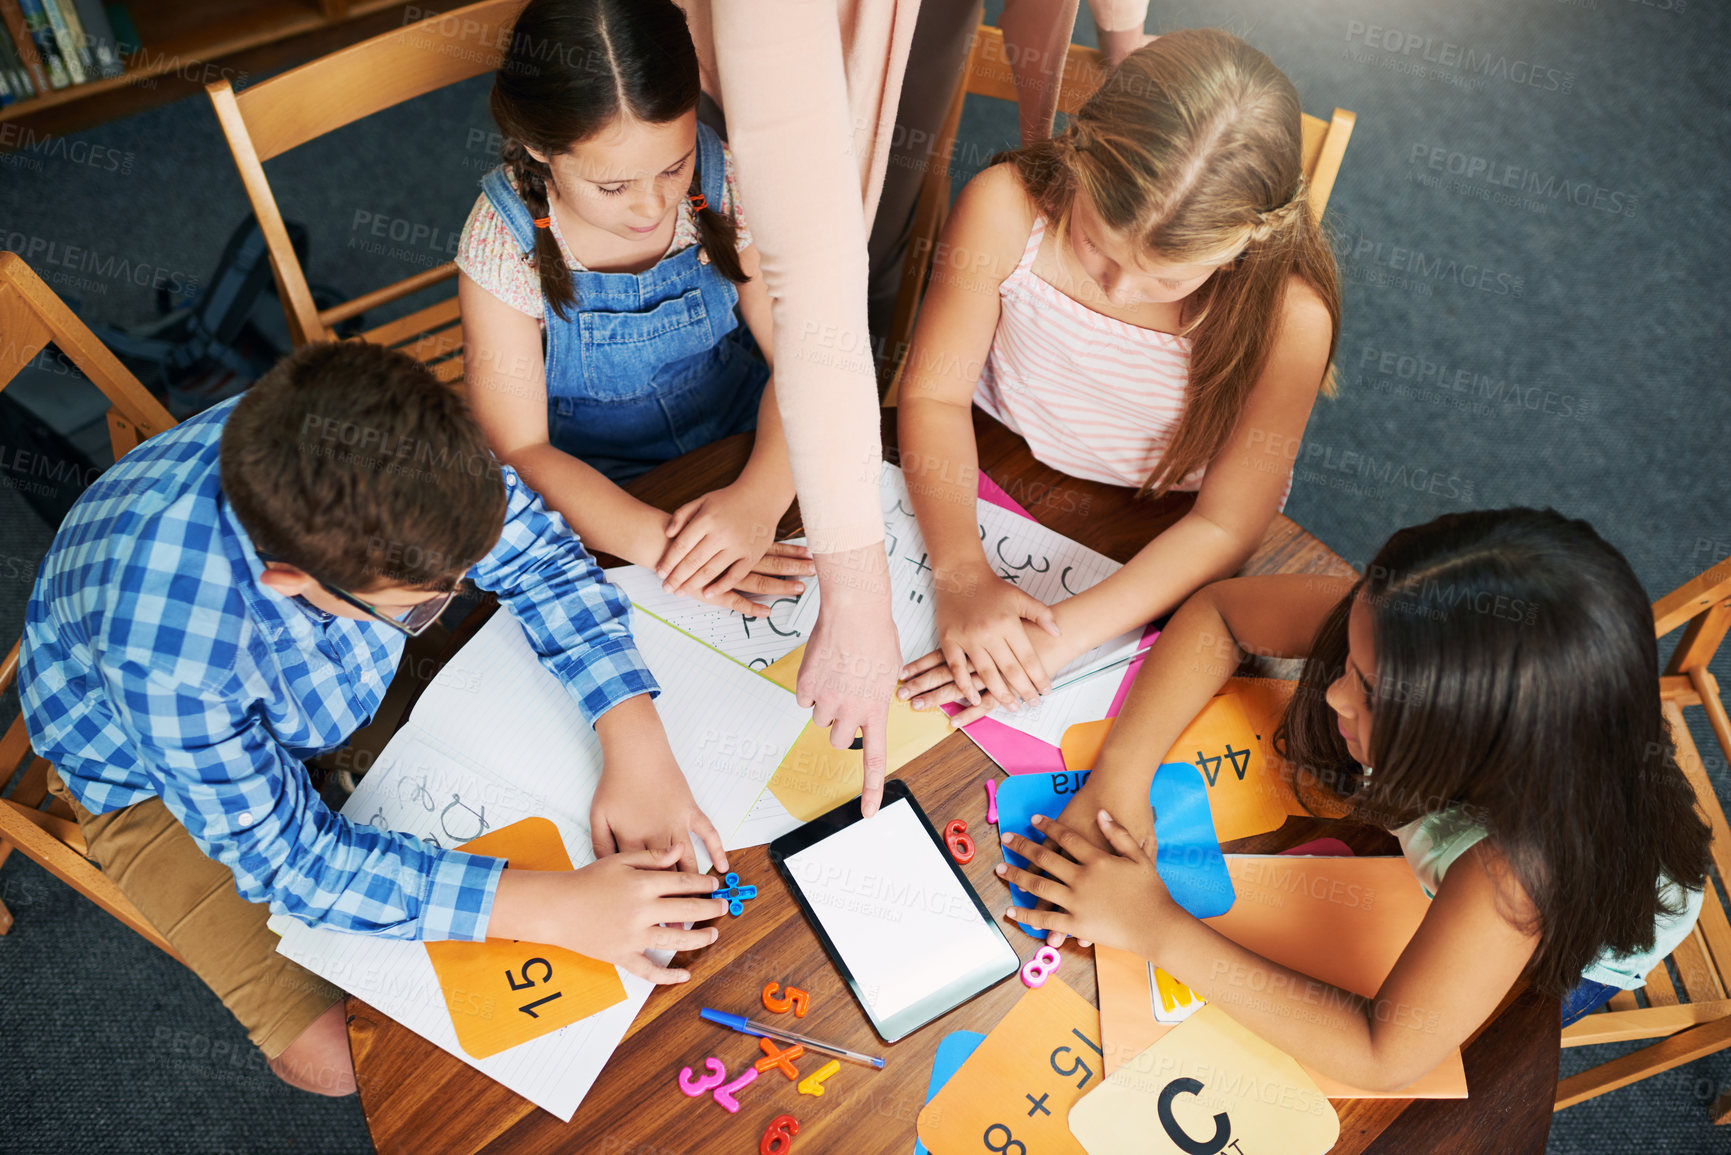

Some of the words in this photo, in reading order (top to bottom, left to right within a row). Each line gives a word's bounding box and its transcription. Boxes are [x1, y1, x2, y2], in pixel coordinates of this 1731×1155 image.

[1195, 744, 1251, 787] 44
[944, 819, 976, 865] 6
[505, 957, 562, 1019] 15
[1021, 945, 1062, 988] 8
[762, 981, 810, 1018] 5
[679, 1057, 726, 1097] 3
[1157, 1077, 1232, 1155] C
